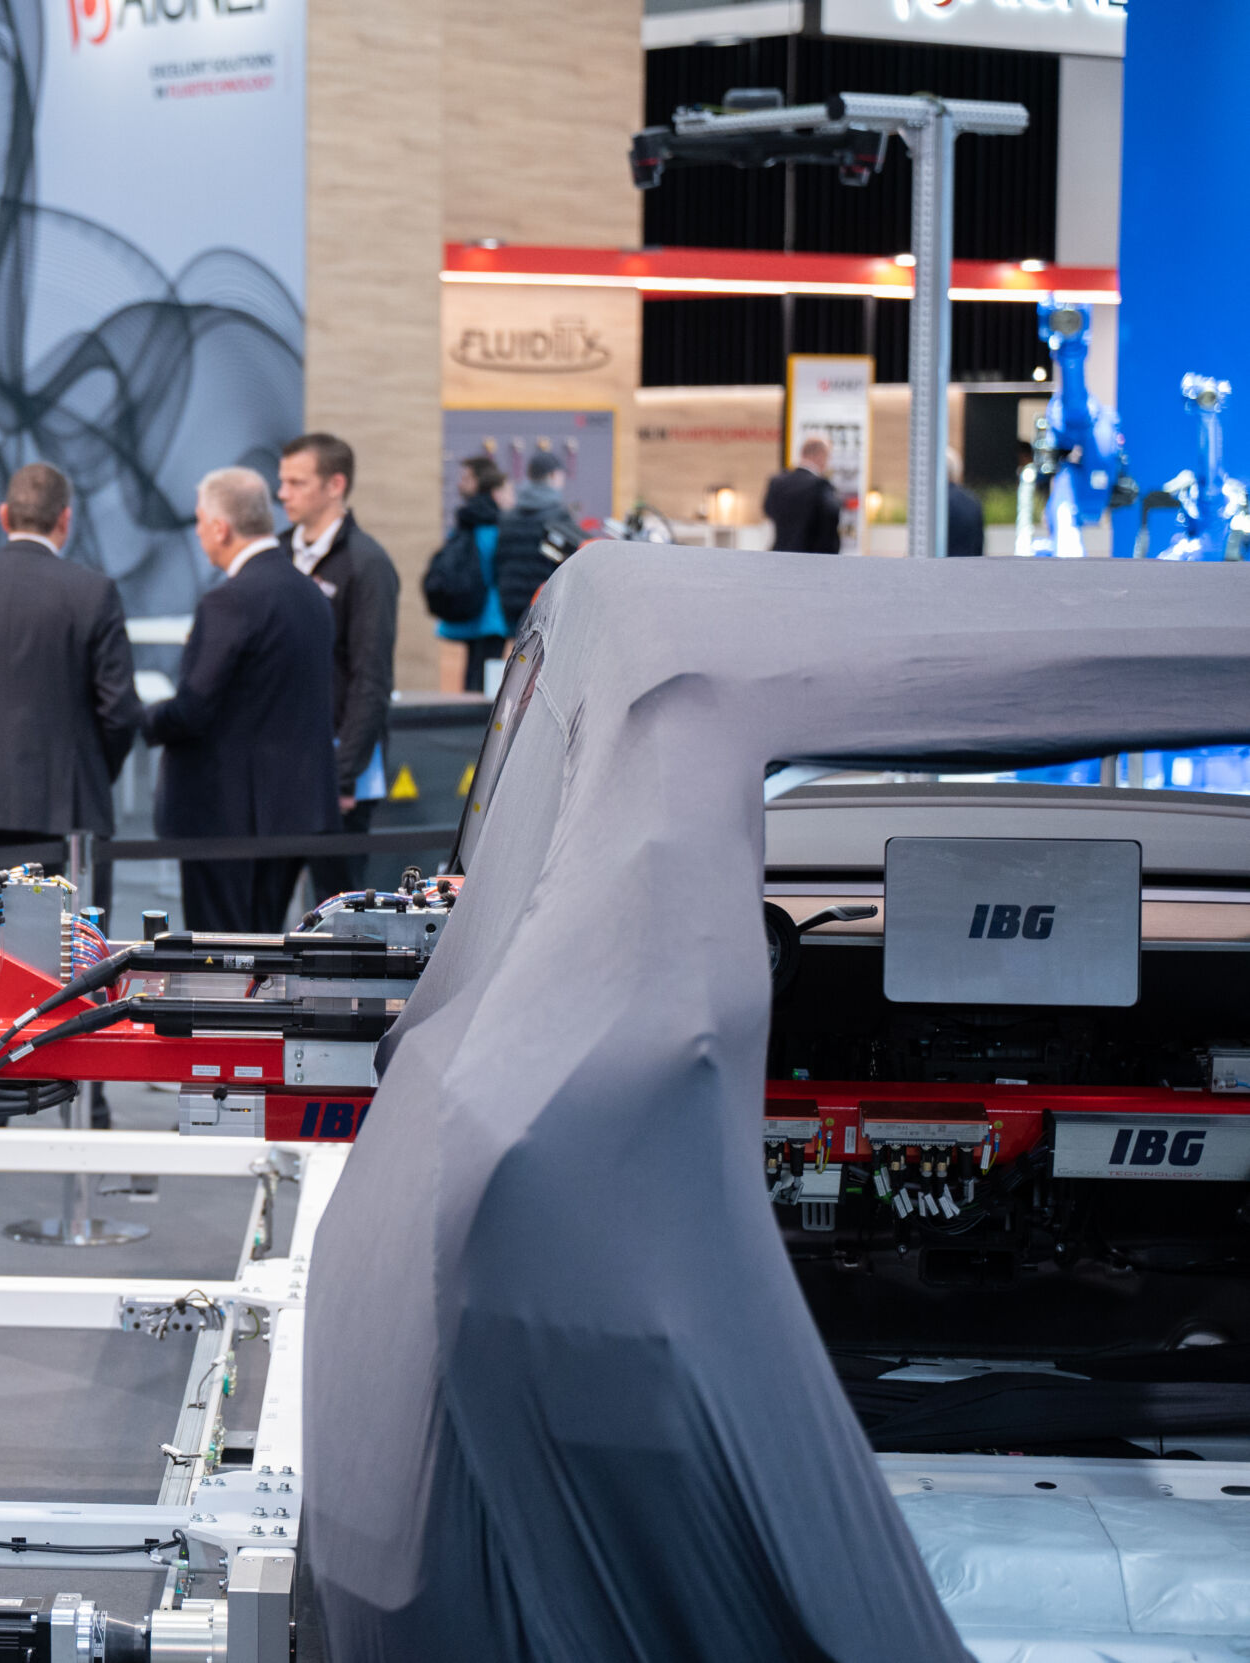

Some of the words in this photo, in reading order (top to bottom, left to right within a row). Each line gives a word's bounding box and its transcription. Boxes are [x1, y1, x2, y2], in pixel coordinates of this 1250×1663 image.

[968, 904, 1056, 940] IBG
[300, 1102, 371, 1138] IB
[1109, 1129, 1207, 1167] IBG
[1109, 1170, 1203, 1178] TECHNOLOGY
